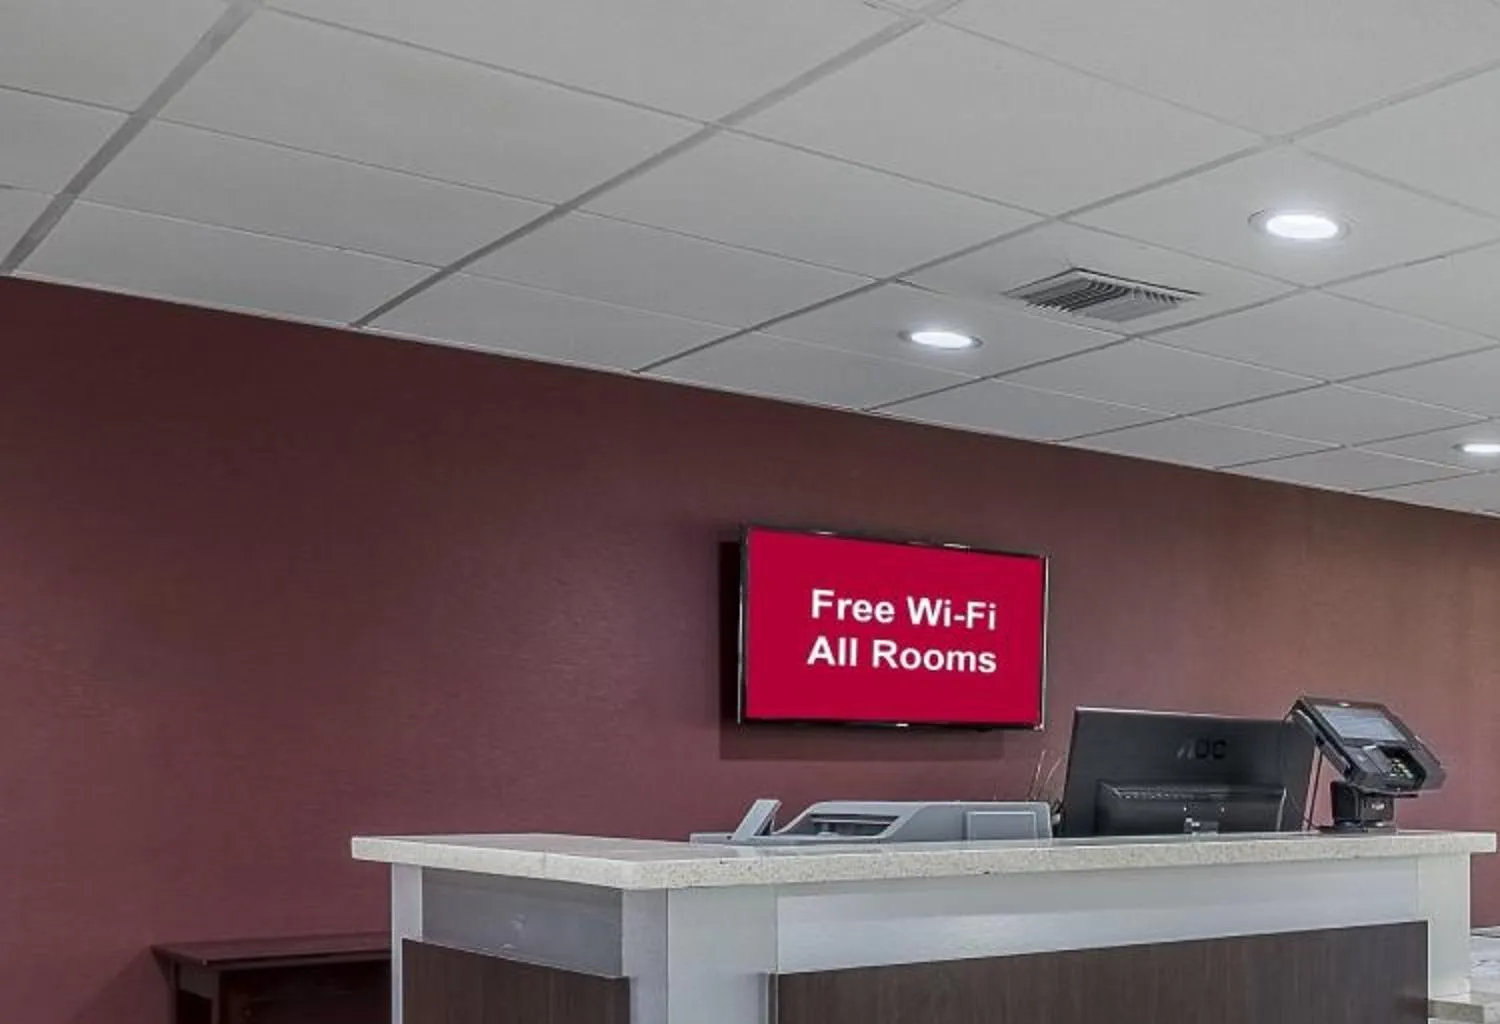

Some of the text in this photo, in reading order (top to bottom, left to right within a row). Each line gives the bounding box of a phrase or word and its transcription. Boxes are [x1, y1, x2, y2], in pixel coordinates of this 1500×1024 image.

[810, 588, 997, 630] Free Wi-Fi
[807, 635, 997, 673] All Rooms
